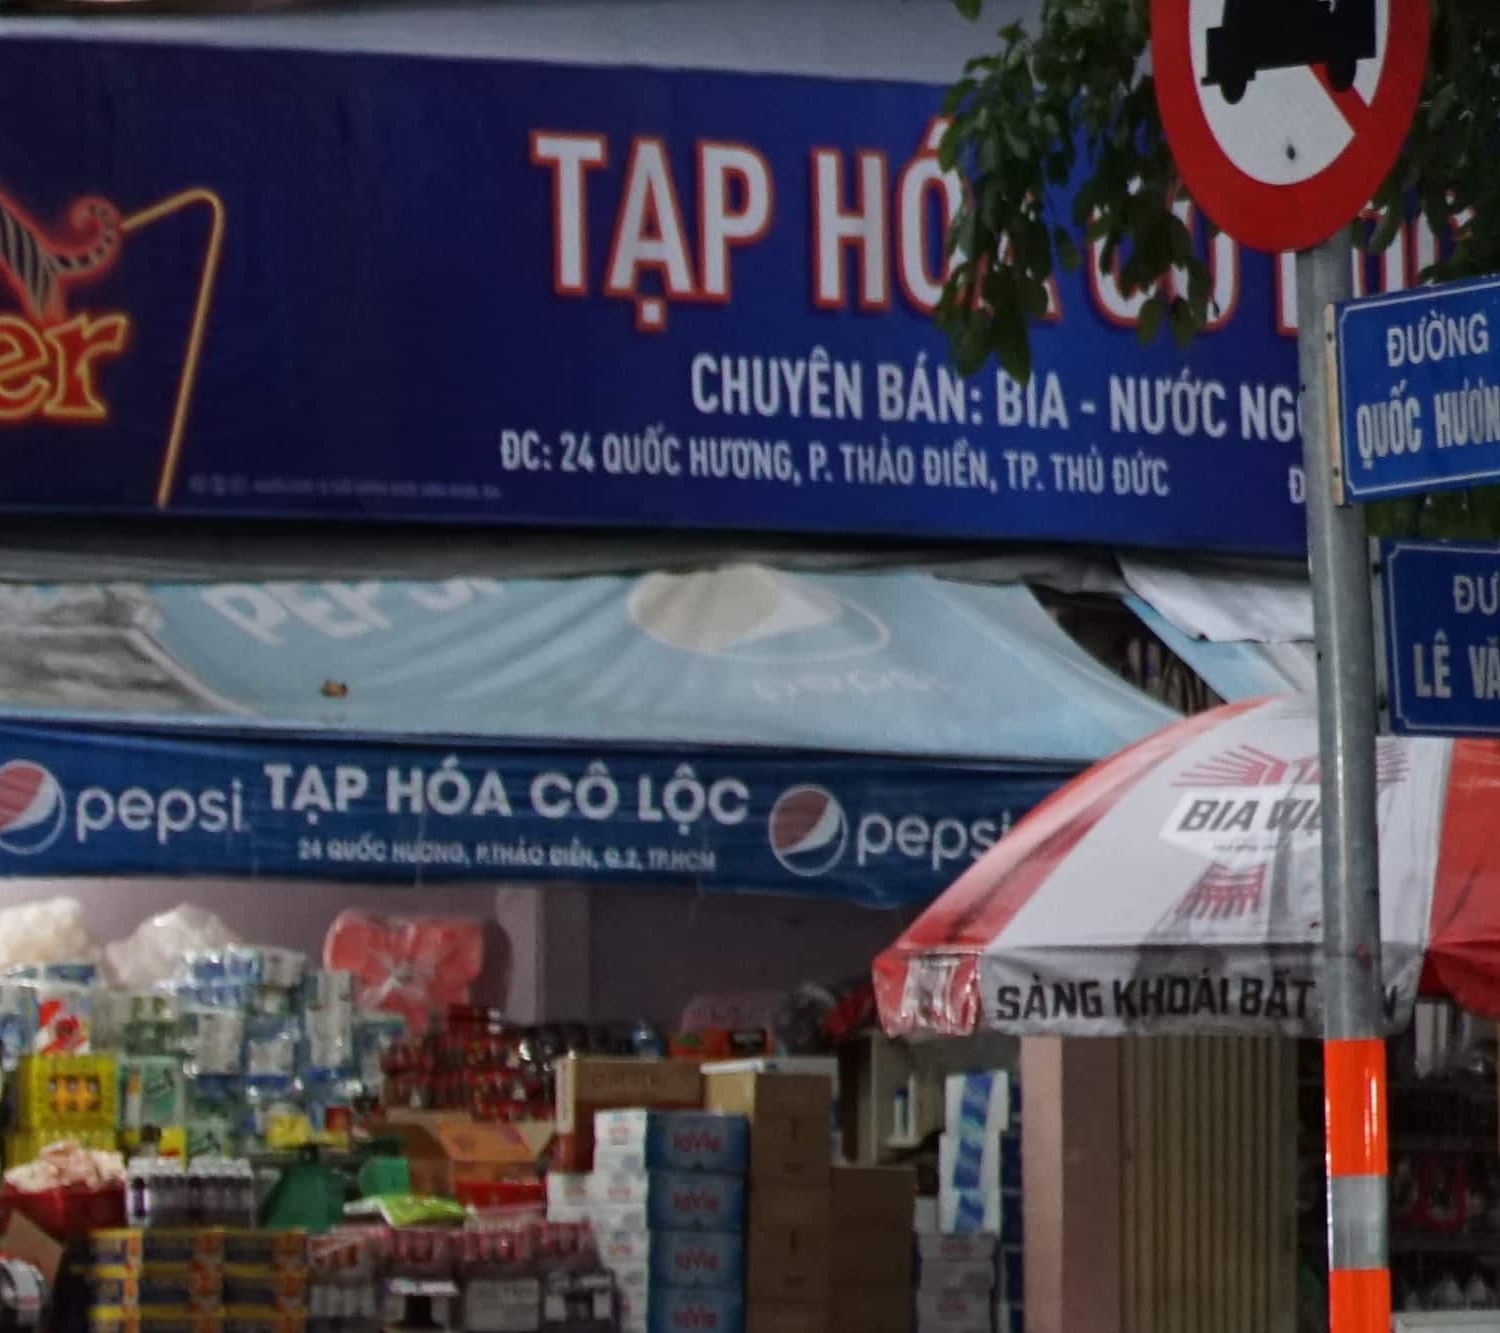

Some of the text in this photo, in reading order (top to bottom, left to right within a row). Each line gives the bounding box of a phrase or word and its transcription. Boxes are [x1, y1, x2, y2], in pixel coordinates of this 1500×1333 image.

[530, 129, 772, 331] TẠP
[1386, 313, 1489, 367] ĐƯỜNG
[691, 344, 863, 419] CHUYÊN
[877, 351, 984, 425] BÁN:
[1110, 367, 1228, 438] NƯỚC
[1240, 384, 1303, 443] NG
[1356, 380, 1423, 470] QUỐC
[500, 430, 553, 471] ĐC:
[560, 431, 596, 472] 24
[602, 422, 682, 476] QUỐC
[690, 434, 803, 486] HƯƠNG,
[809, 441, 833, 482] P.
[839, 433, 914, 486] THẢO
[1005, 451, 1045, 492] TP.
[1112, 450, 1171, 497] ĐỨC
[1412, 630, 1451, 699] LÊ
[76, 779, 245, 845] pepsi
[263, 764, 369, 825] TẠP
[386, 754, 513, 819] HÓA
[529, 760, 619, 821] CÔ
[636, 762, 750, 836] LỘC
[1177, 798, 1260, 833] BIA
[1113, 969, 1230, 1018] KHOÁI
